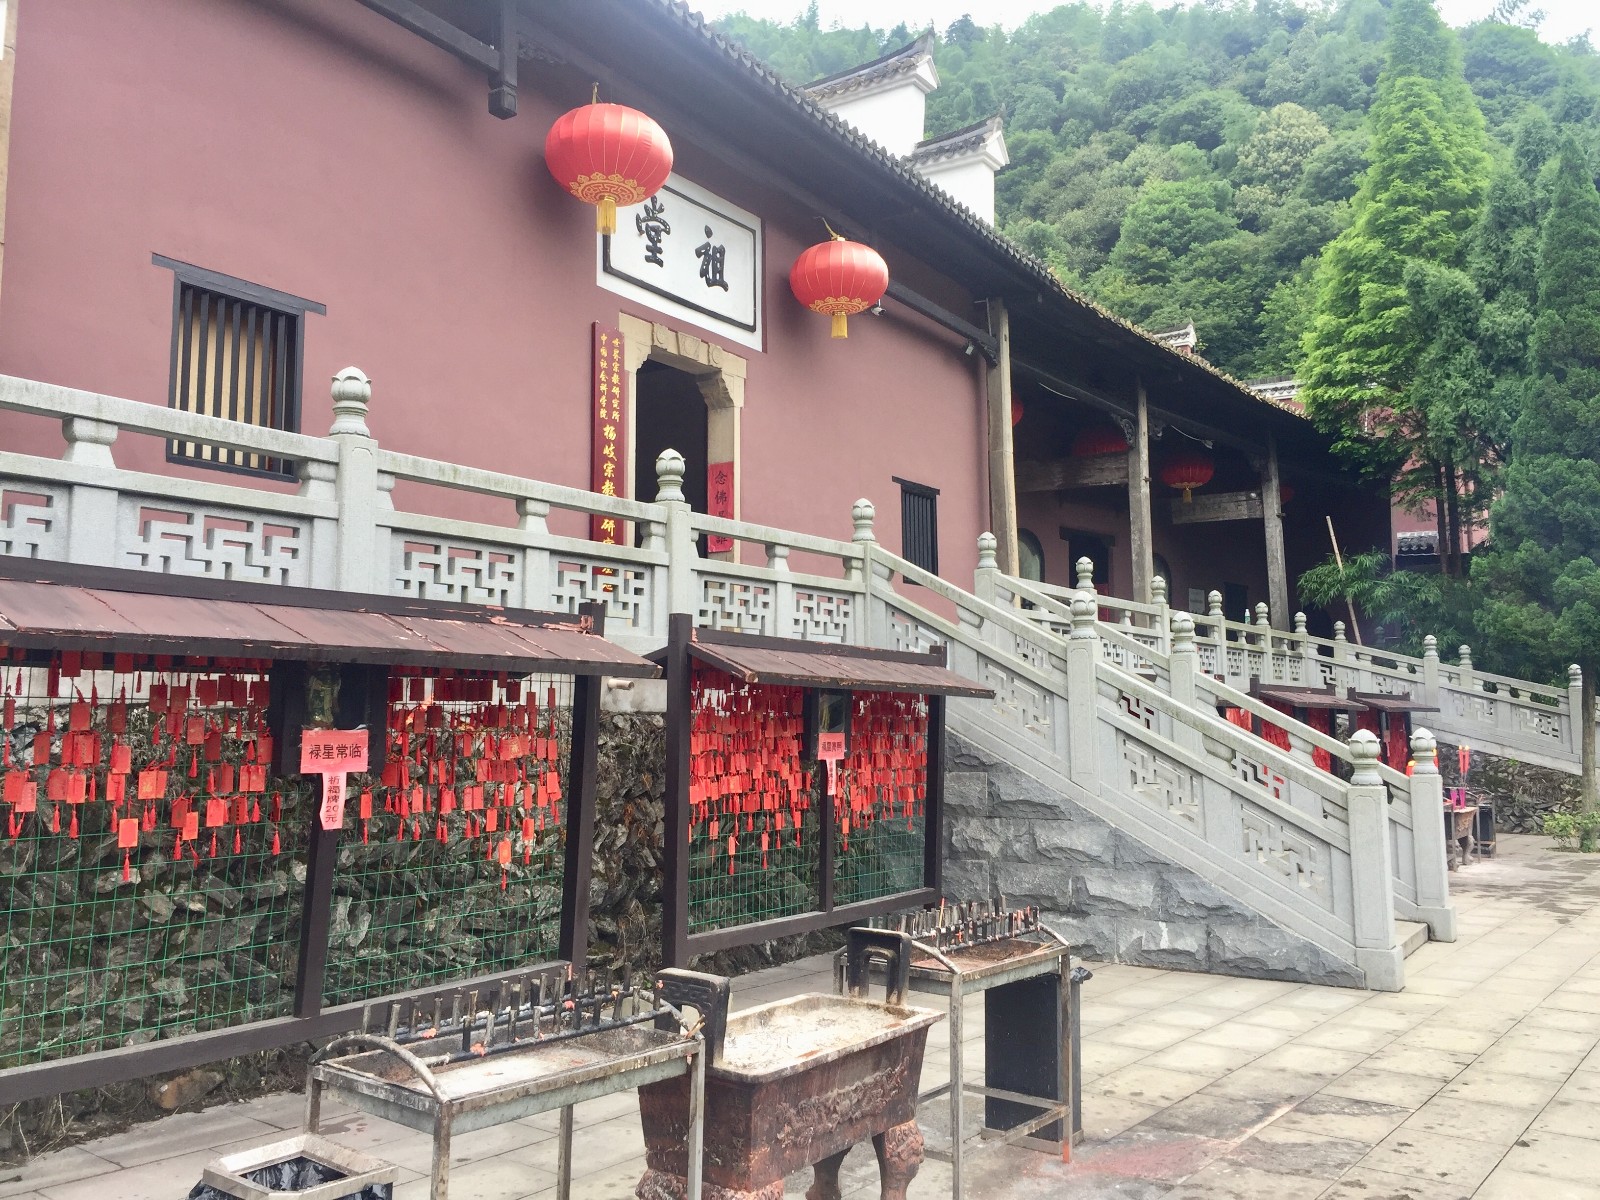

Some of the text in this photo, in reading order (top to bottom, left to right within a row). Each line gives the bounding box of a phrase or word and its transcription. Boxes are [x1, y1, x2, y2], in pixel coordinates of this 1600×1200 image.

[636, 195, 729, 292] 祖堂
[309, 743, 361, 760] 禄星常临
[325, 776, 340, 823] 祈福牌20元
